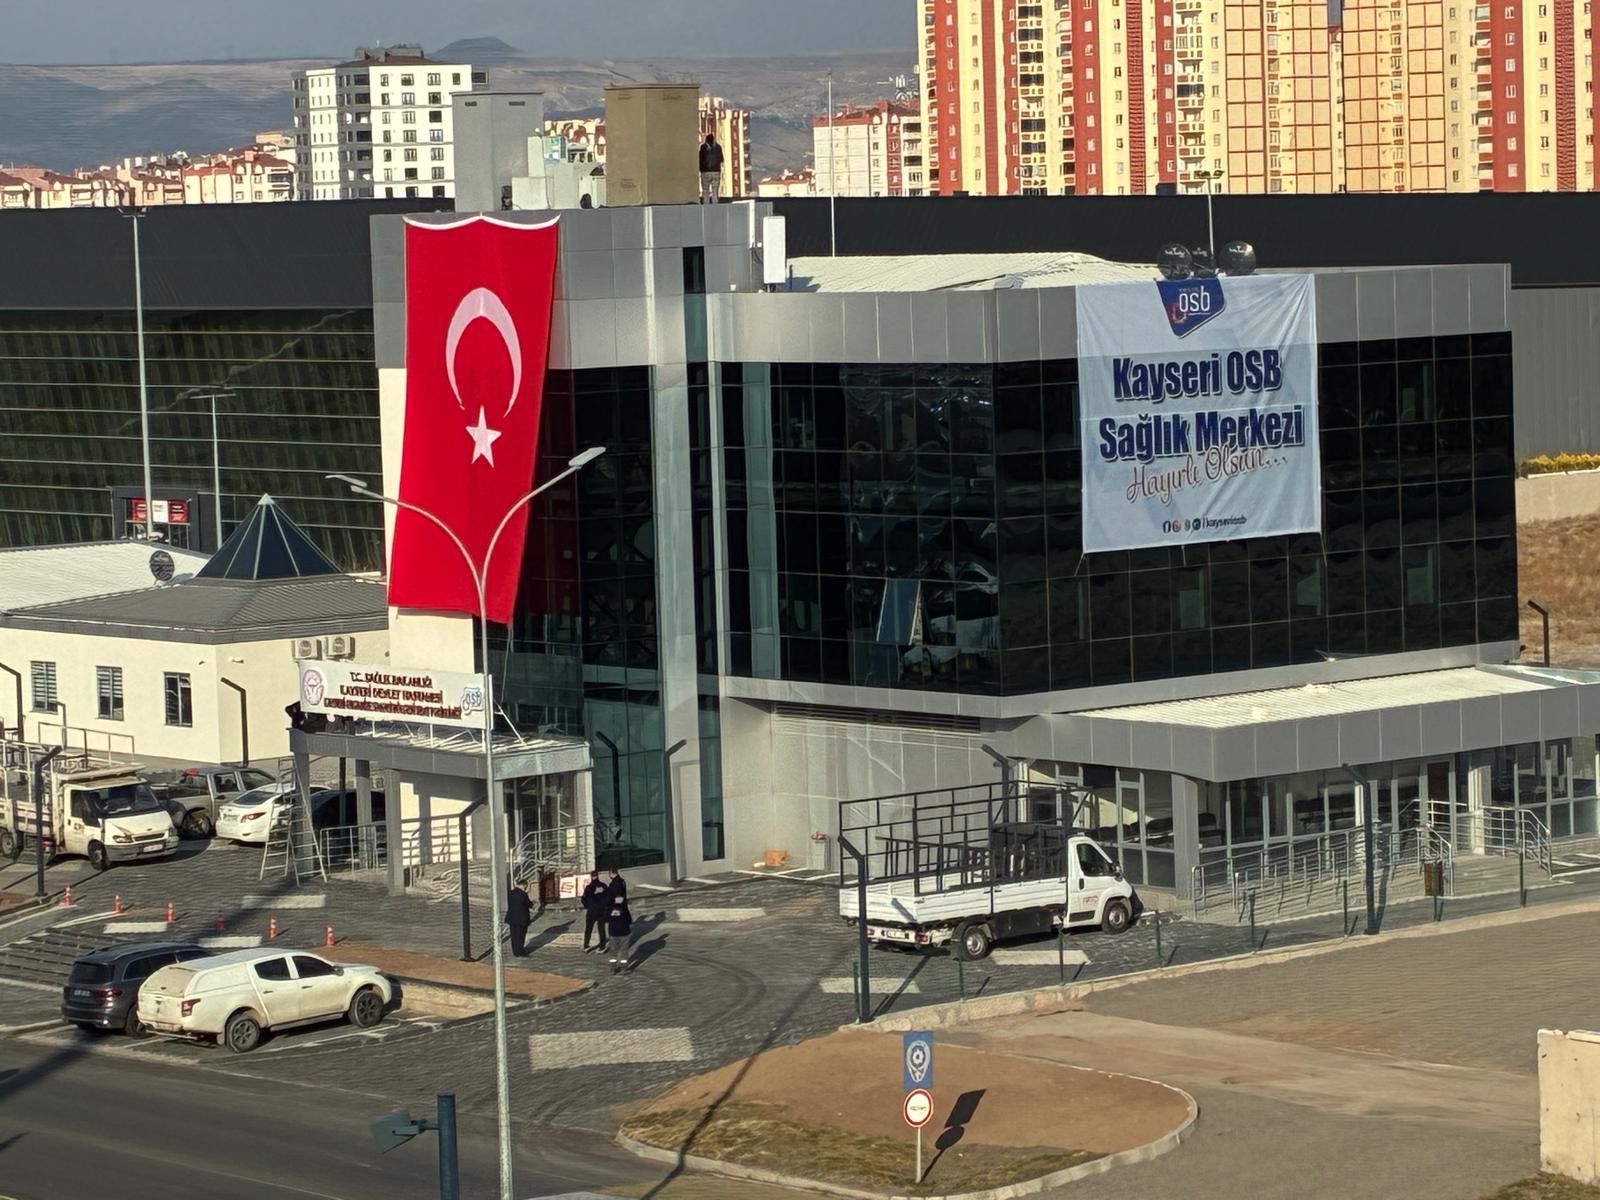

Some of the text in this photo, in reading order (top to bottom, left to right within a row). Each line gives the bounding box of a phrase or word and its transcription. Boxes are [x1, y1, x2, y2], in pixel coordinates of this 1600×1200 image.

[1179, 285, 1210, 312] osb
[1113, 349, 1282, 403] Kayseri OSB
[1100, 405, 1304, 462] Sağlık Merkezi
[1126, 455, 1201, 506] Hayırlı
